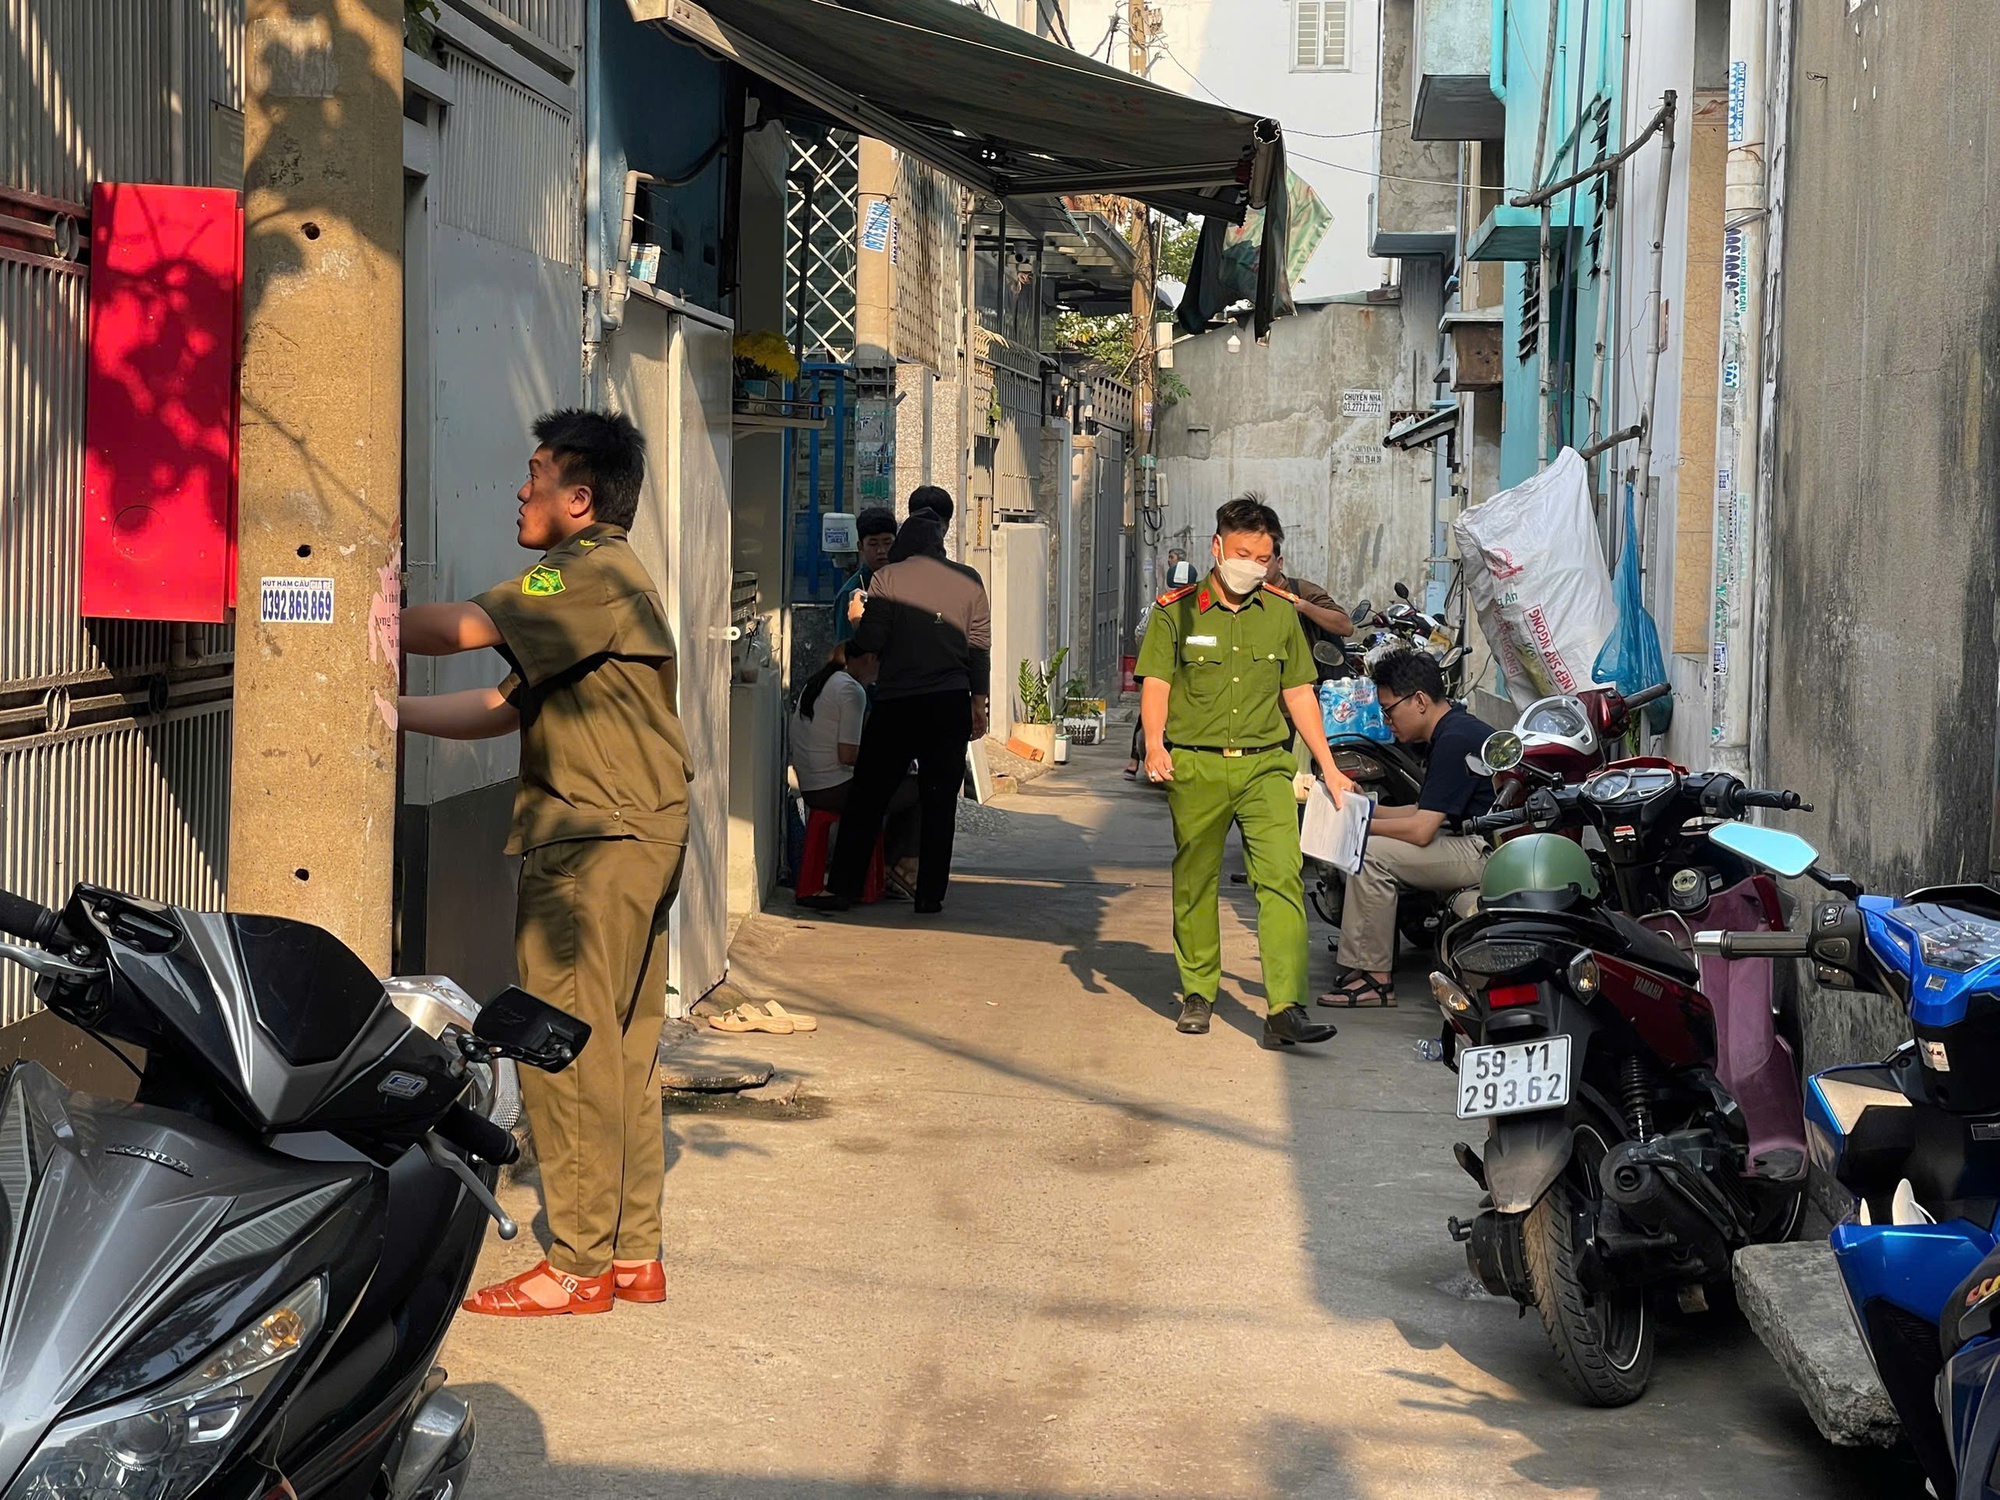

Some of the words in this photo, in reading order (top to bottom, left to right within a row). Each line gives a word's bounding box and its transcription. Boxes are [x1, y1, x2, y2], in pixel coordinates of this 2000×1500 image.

[262, 589, 332, 621] 0392.869.869
[1633, 974, 1664, 1001] YAMAHA
[387, 1074, 424, 1092] FI
[1463, 1073, 1562, 1113] 293.62
[105, 1144, 194, 1178] HONDA
